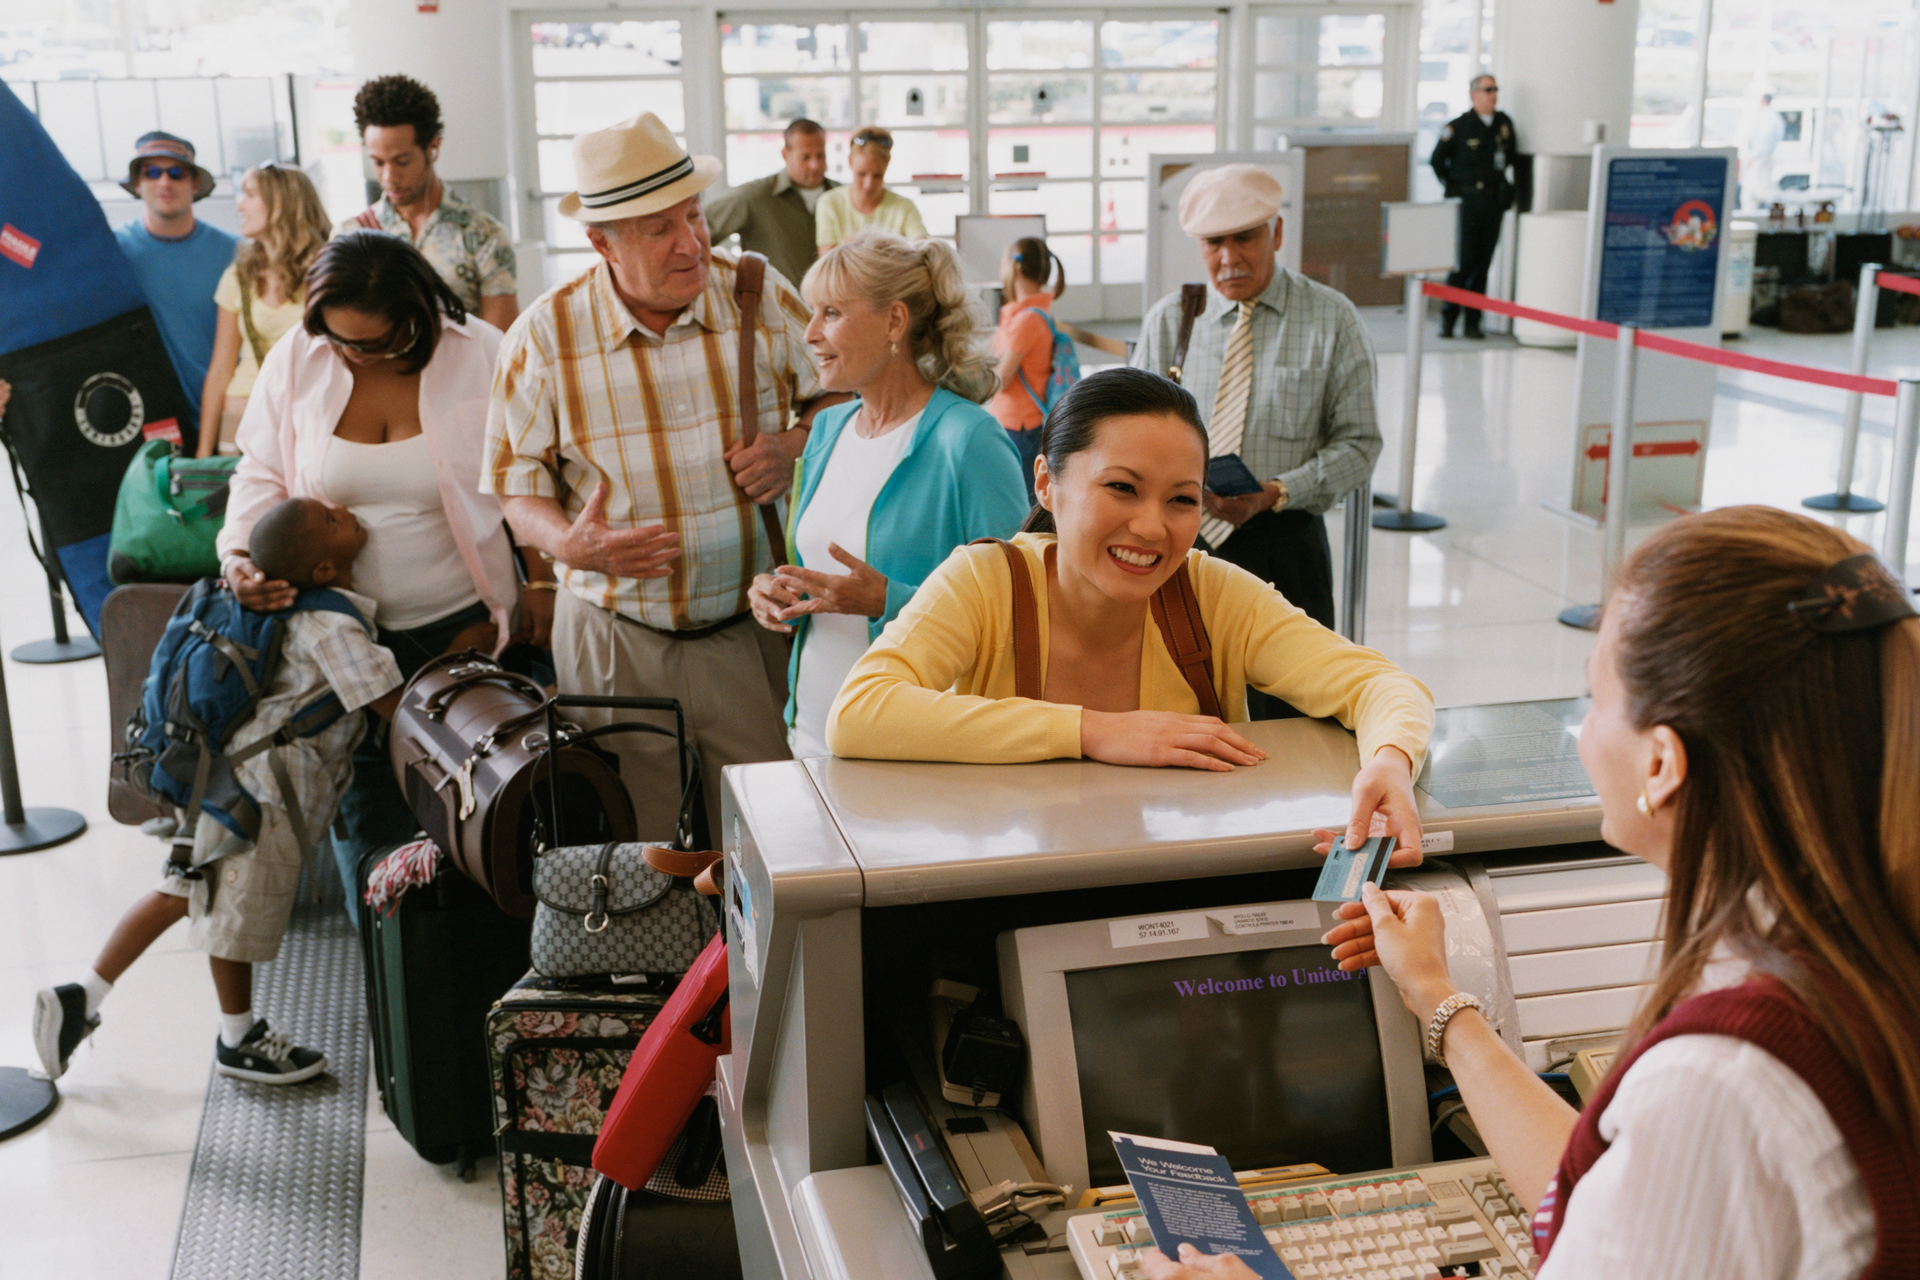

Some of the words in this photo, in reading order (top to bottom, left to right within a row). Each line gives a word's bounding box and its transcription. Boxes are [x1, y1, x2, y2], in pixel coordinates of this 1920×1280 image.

[1138, 921, 1174, 932] WONT4021
[1138, 928, 1180, 939] 57.14.91.167
[1174, 977, 1264, 997] Welcome
[1270, 973, 1287, 988] to
[1292, 966, 1352, 985] United
[1137, 1156, 1158, 1166] We
[1159, 1160, 1214, 1174] Welcome
[1140, 1164, 1167, 1176] Your
[1170, 1170, 1227, 1183] Feedback
